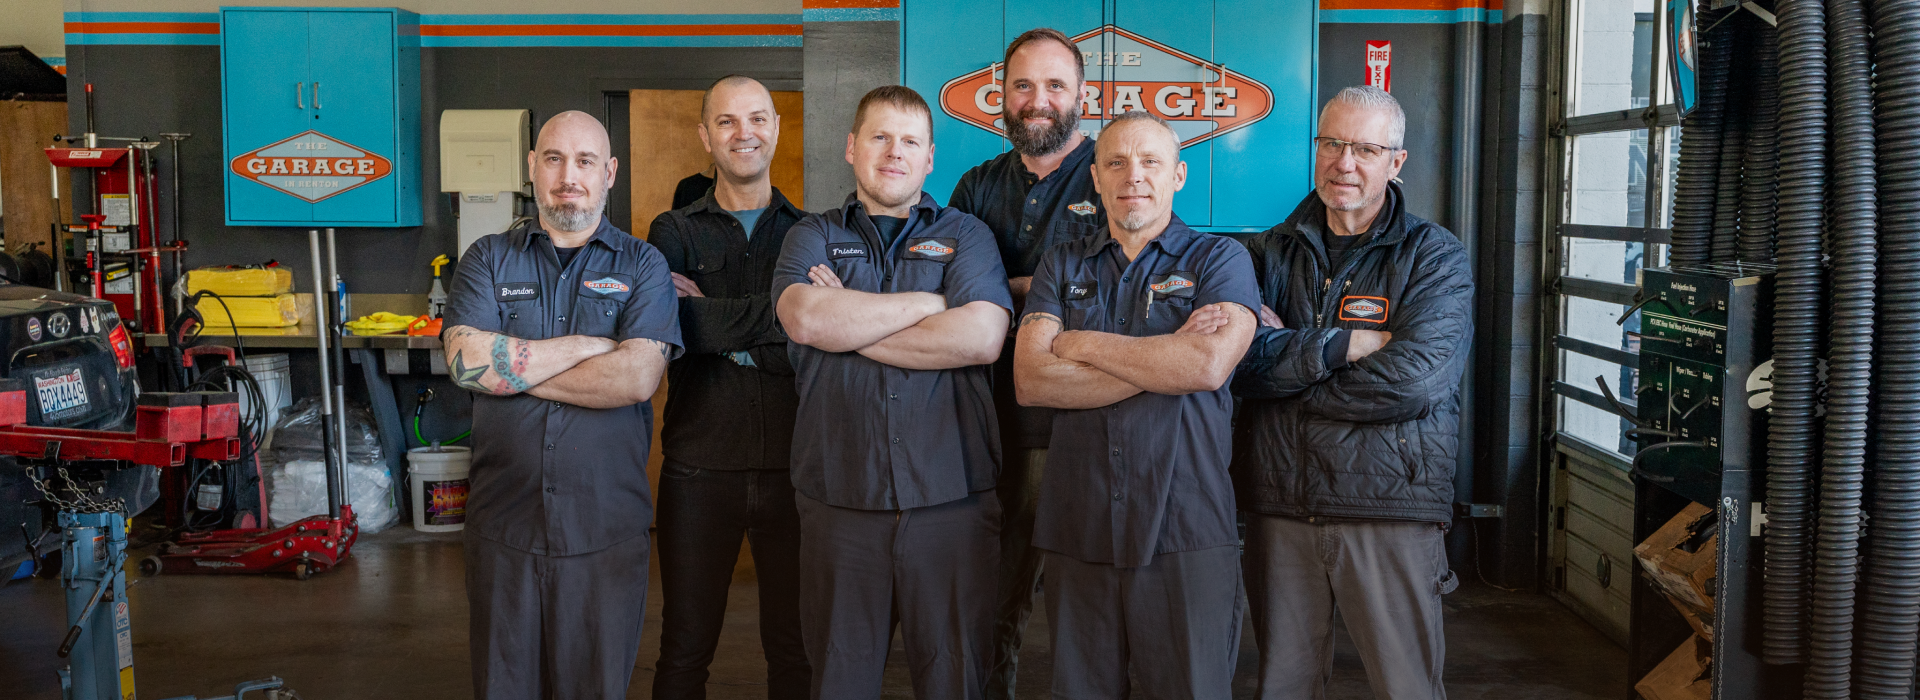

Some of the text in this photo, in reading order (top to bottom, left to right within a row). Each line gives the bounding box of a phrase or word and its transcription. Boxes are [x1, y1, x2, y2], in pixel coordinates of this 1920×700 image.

[1370, 51, 1387, 61] FIRE
[974, 83, 1237, 118] GRAGE
[294, 142, 327, 150] THE
[247, 158, 375, 175] GARAGE
[284, 180, 339, 188] IN RENTON
[913, 244, 950, 254] GARAGE
[588, 282, 626, 291] GARAGE
[1154, 280, 1189, 290] GARAGE
[501, 287, 535, 297] Brandon
[1070, 285, 1088, 296] Tony
[37, 377, 65, 388] WASHINGTON
[40, 381, 86, 412] BQX4449
[117, 617, 128, 628] OTC
